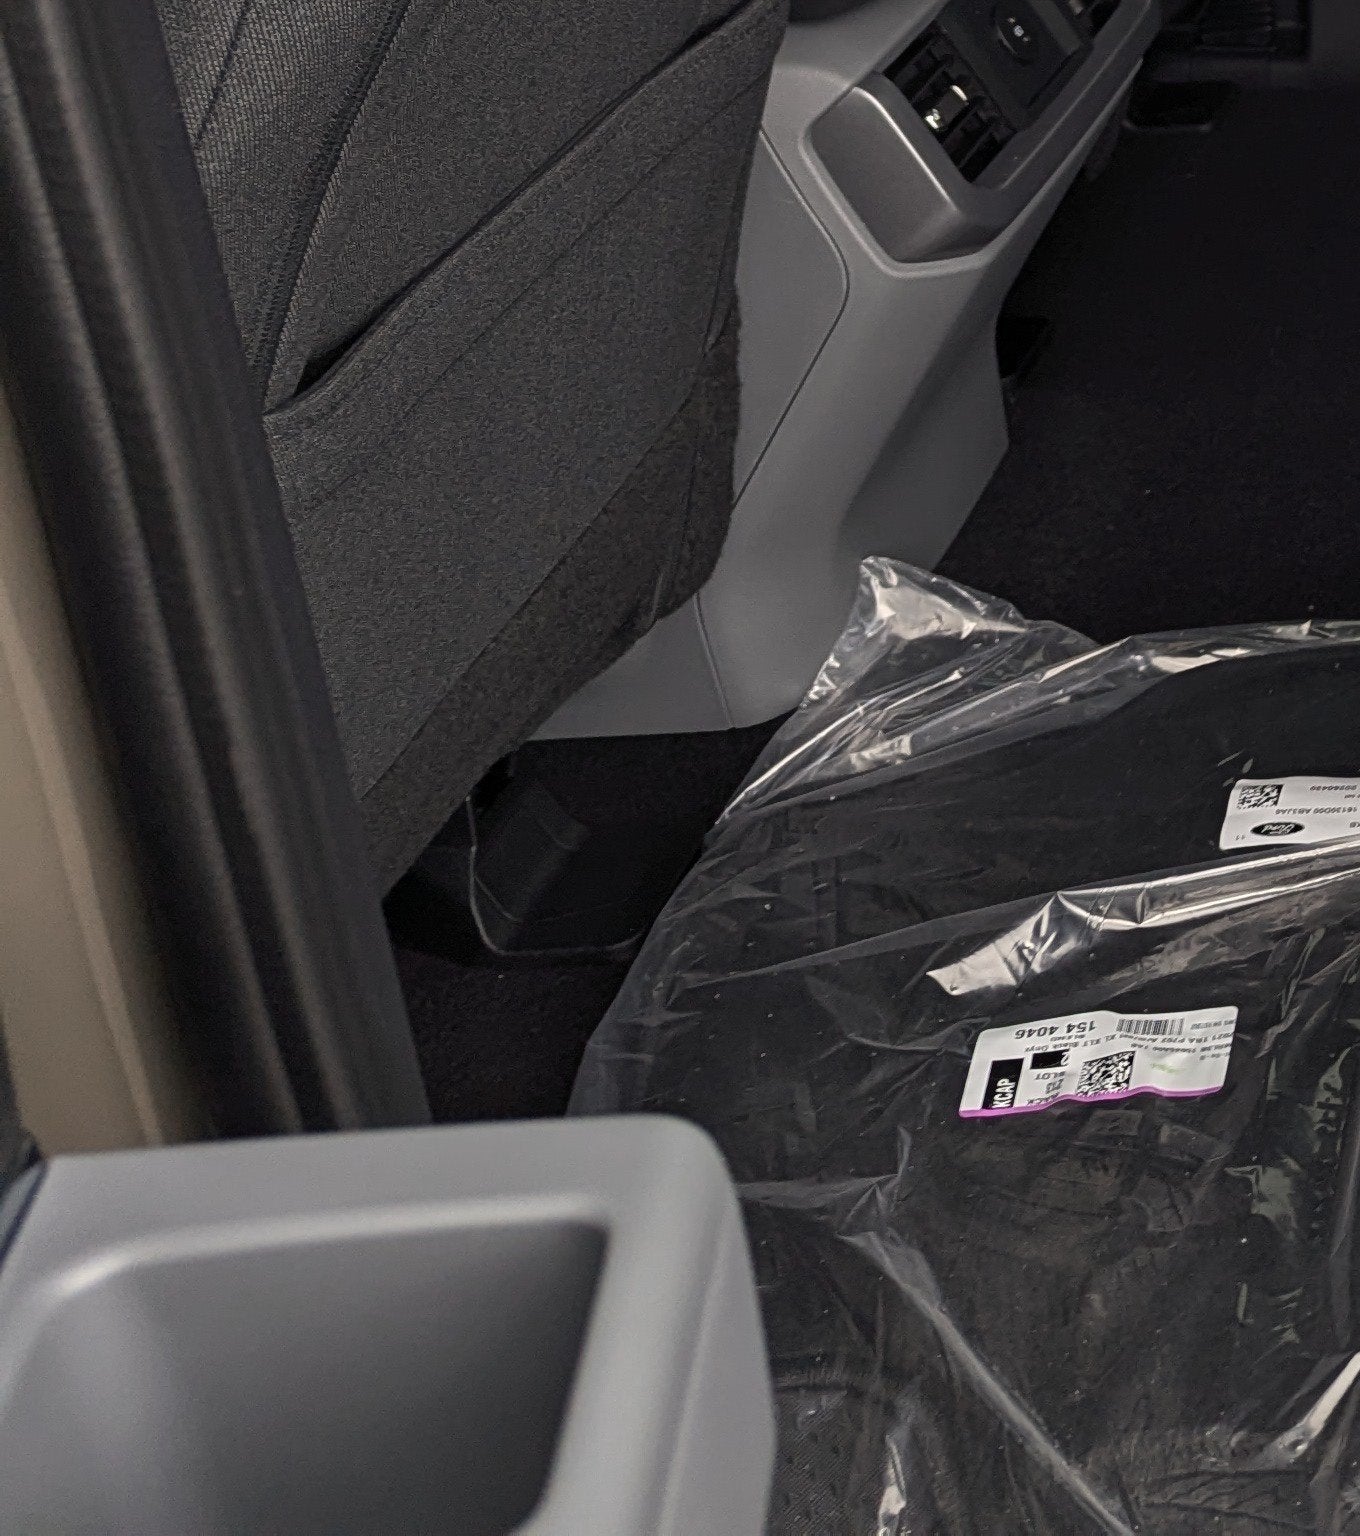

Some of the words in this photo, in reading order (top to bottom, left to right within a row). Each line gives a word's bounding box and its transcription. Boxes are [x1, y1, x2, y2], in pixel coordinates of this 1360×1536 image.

[1258, 823, 1298, 835] Ford
[1014, 1025, 1059, 1040] 4046
[1067, 1020, 1095, 1034] 154
[991, 1078, 1015, 1108] KCAP
